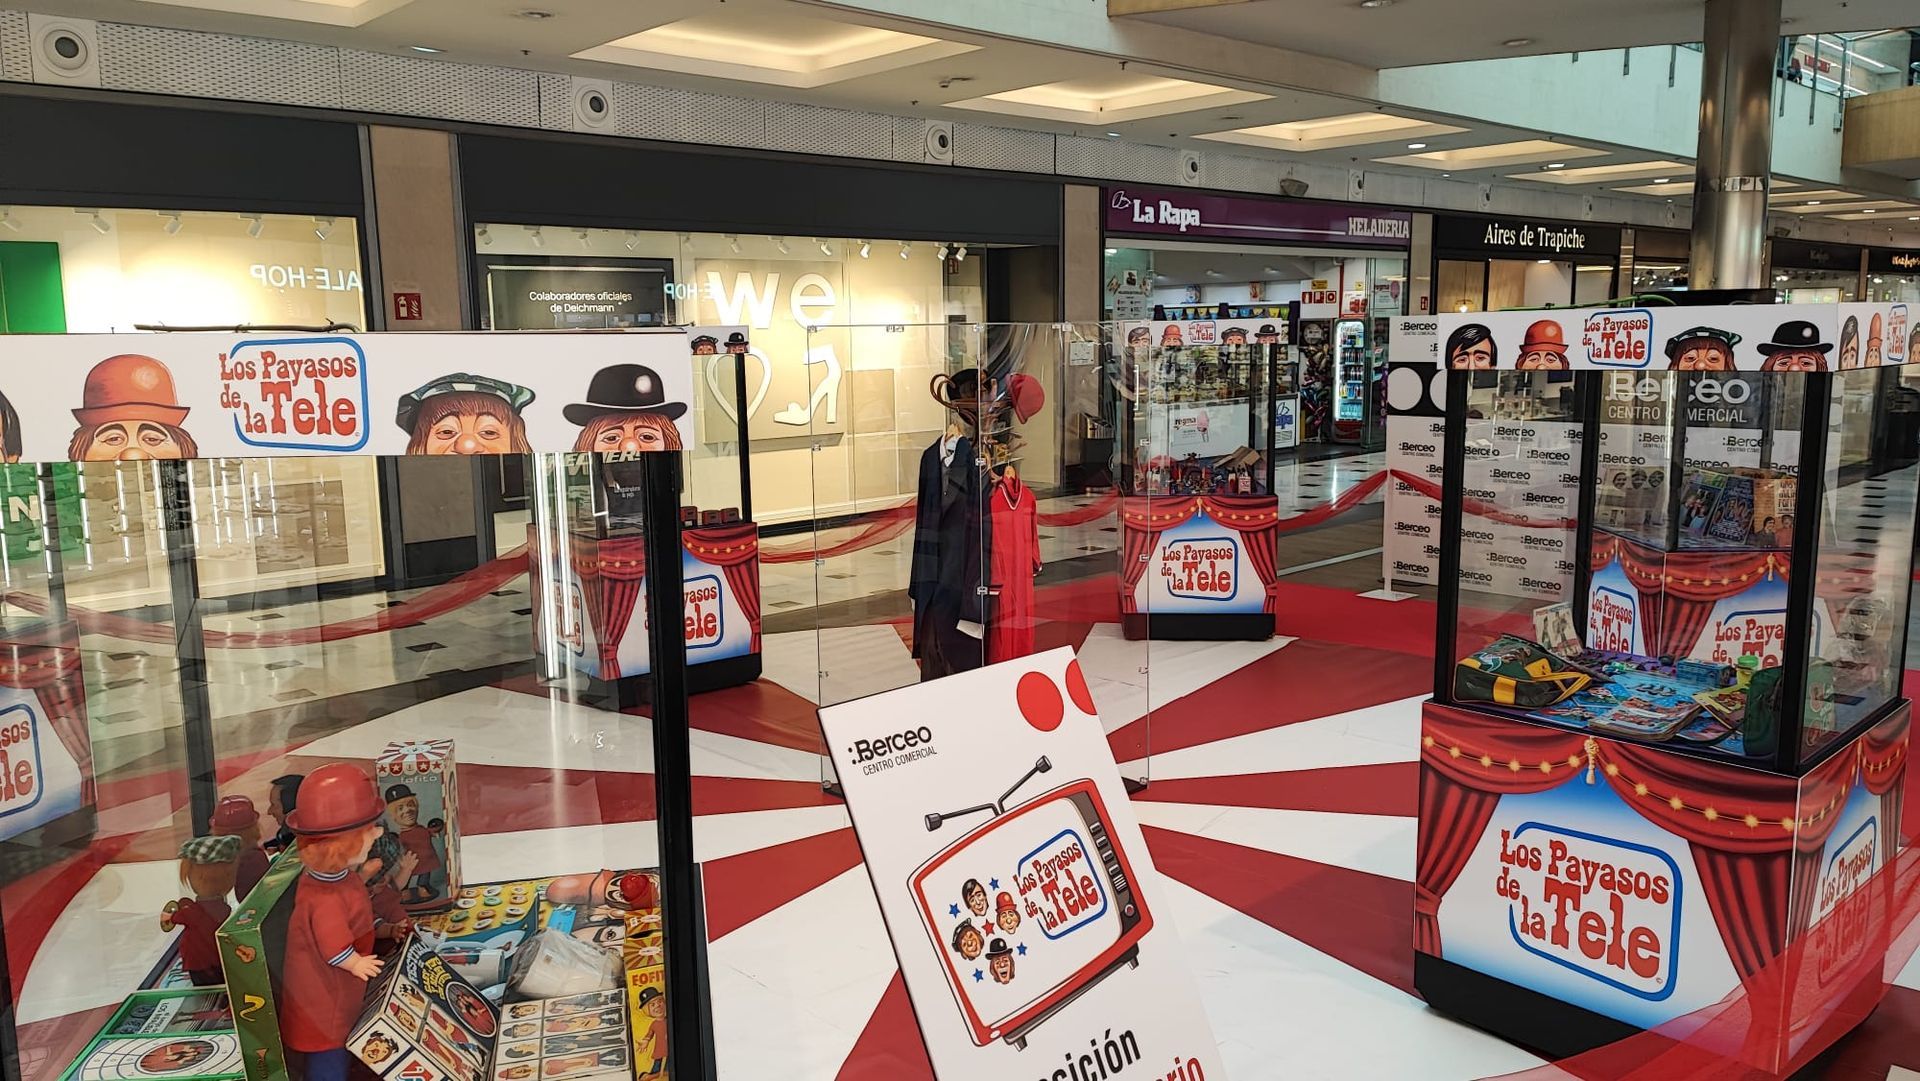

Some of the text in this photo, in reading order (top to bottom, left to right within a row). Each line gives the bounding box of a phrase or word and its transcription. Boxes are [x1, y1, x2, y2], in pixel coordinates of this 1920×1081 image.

[1133, 199, 1200, 231] La Rapa
[1349, 217, 1410, 239] HELADERIA
[1484, 223, 1586, 252] Aires de Trapiche
[529, 291, 633, 301] Colaboradores oficiales
[550, 303, 615, 313] de Deichmann
[1584, 316, 1648, 335] Los Payasos
[1582, 330, 1646, 360] de la Tele
[218, 350, 357, 386] Los Payasos
[219, 378, 356, 436] de la Tele
[1608, 405, 1661, 420] CENTRO
[1162, 544, 1233, 564] Los Payasos
[1161, 560, 1231, 593] de la Tele
[1603, 594, 1633, 626] Payasos
[1715, 620, 1742, 641] Los
[1712, 643, 1728, 662] de
[863, 745, 938, 776] CENTRO COMERCIAL
[1012, 842, 1083, 897] Los Payasos
[1500, 829, 1670, 905] Los Payasos
[1819, 839, 1873, 913] Los Payasos
[1023, 868, 1099, 931] de la Tele
[1496, 866, 1662, 979] de la Tele
[1037, 1028, 1142, 1081] sición
